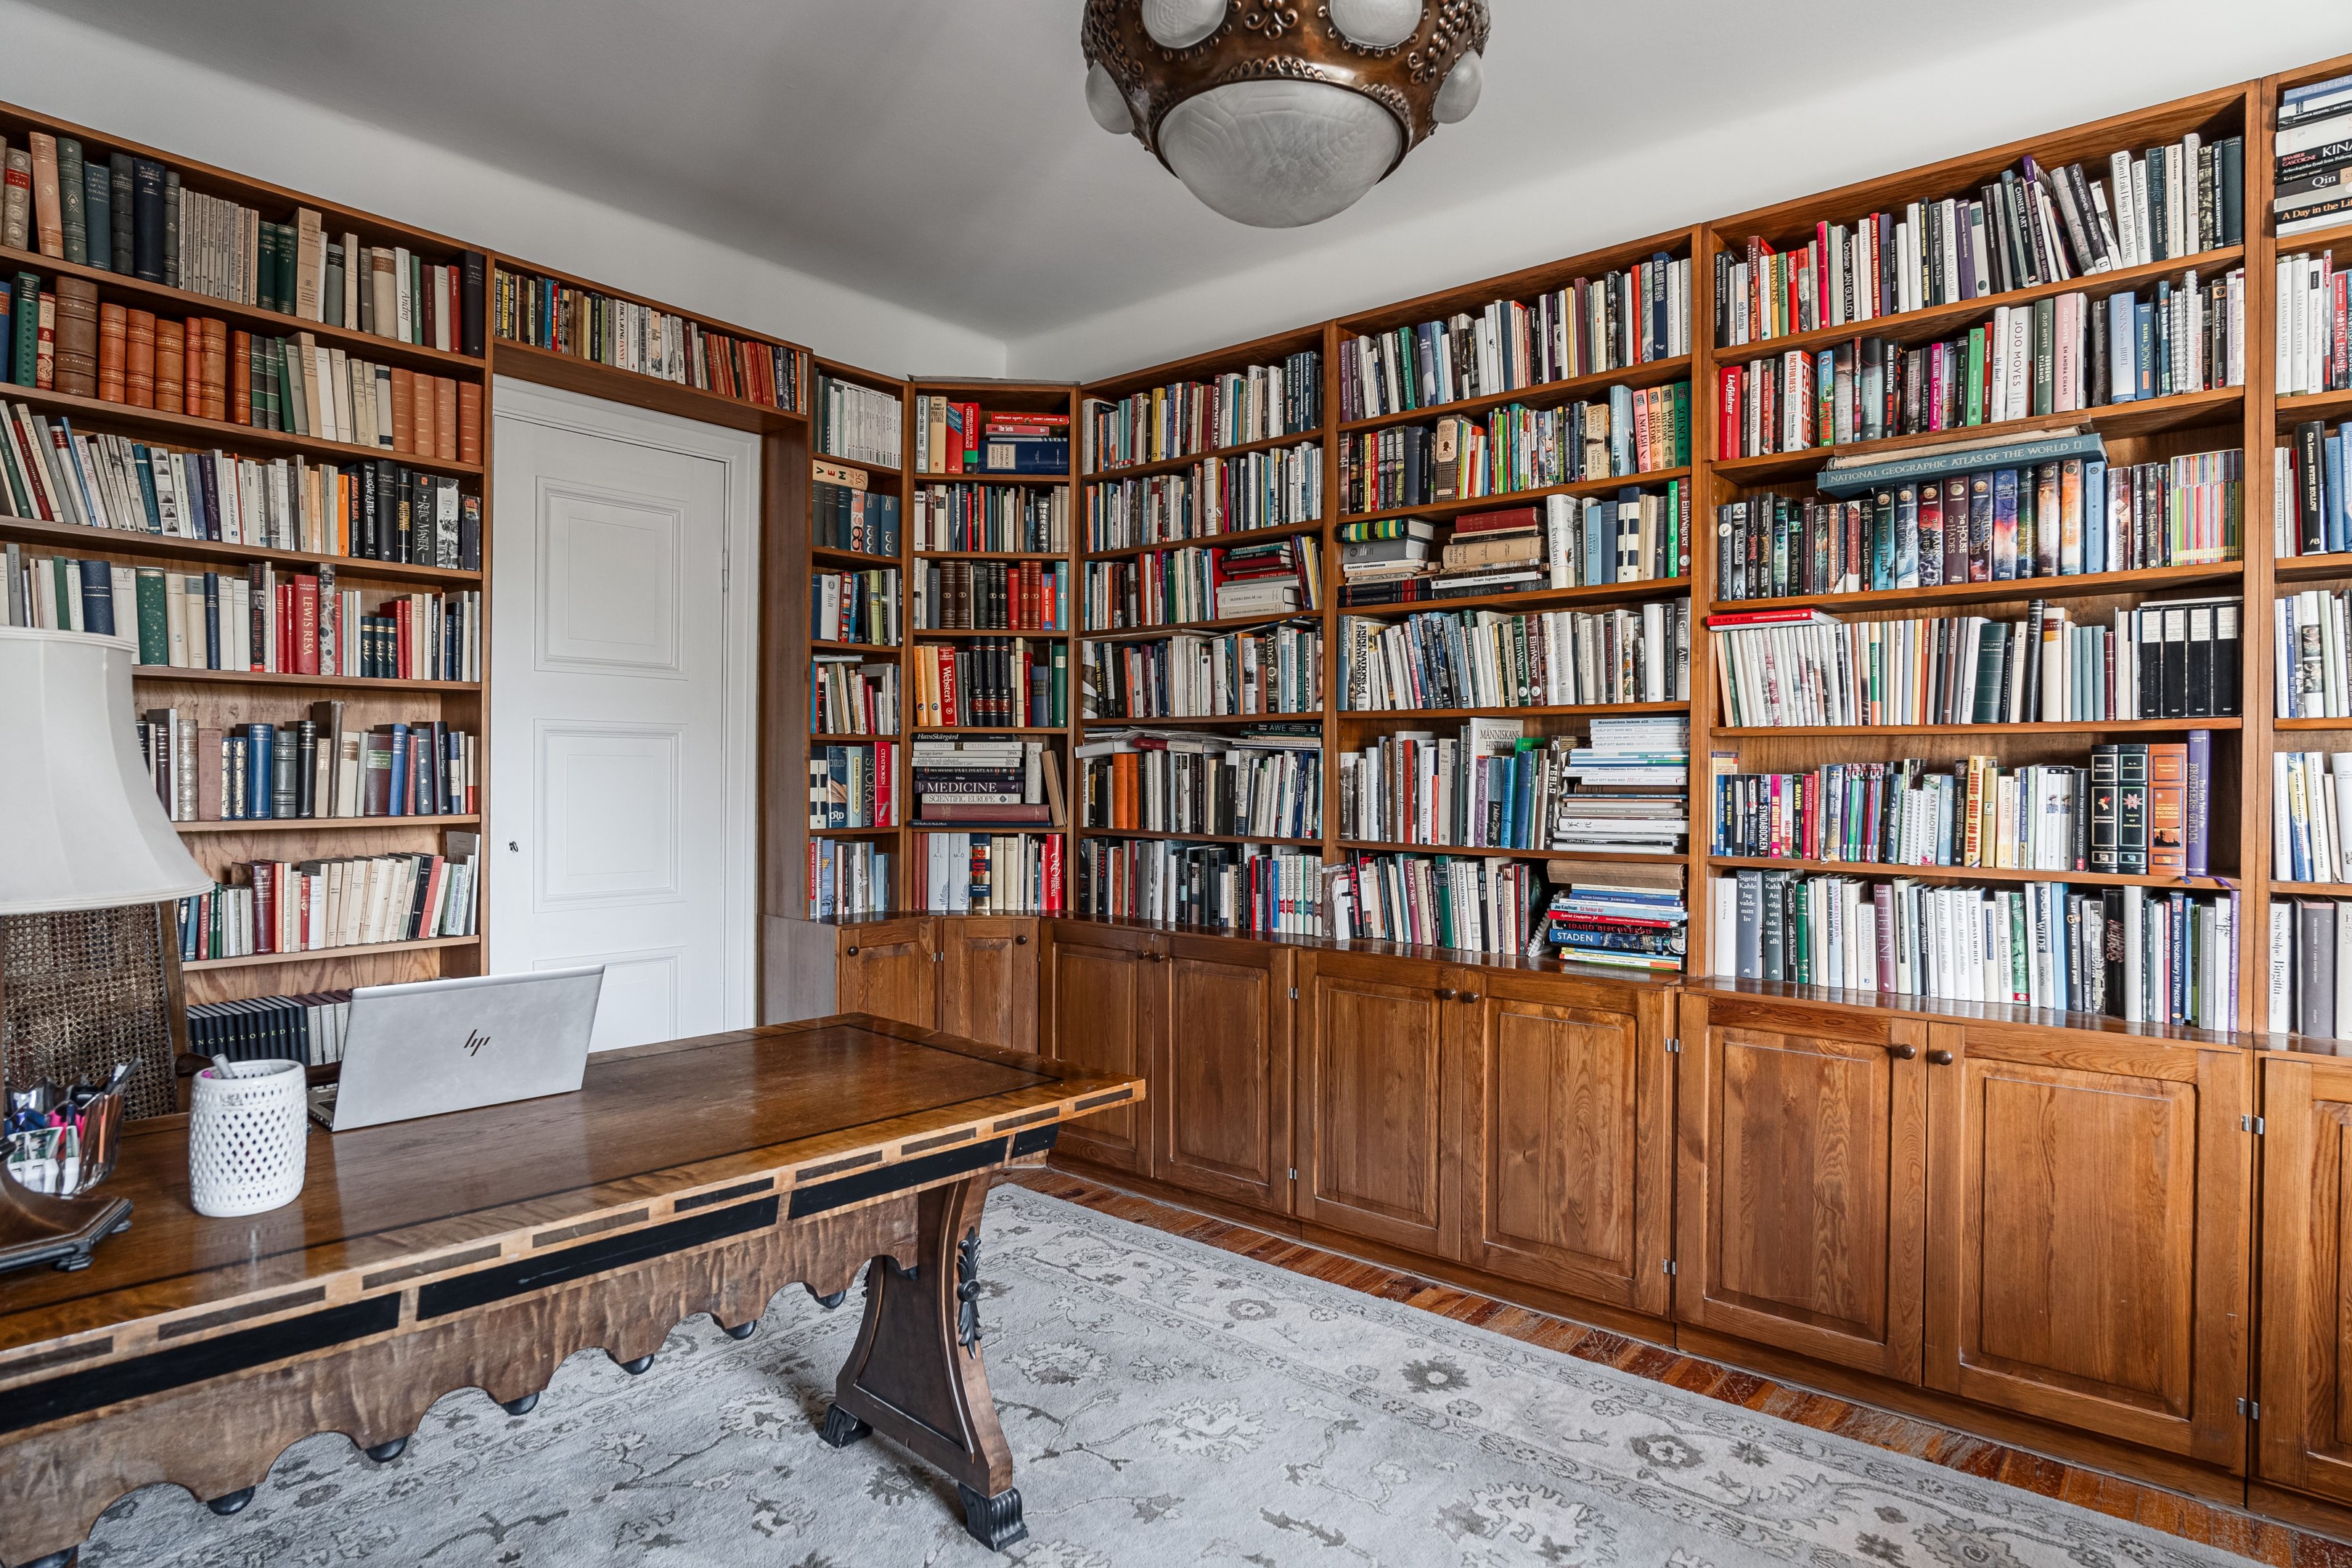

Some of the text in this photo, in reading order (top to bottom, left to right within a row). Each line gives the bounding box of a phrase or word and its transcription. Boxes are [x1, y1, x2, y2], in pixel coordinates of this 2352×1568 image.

[2282, 152, 2305, 161] BAMBER
[2282, 155, 2316, 167] GASCOIGNE
[139, 173, 161, 182] CARNEGIE
[2312, 176, 2336, 187] Qin
[2015, 187, 2024, 215] CHINESE
[2292, 207, 2309, 218] Day
[2323, 201, 2339, 212] the
[401, 290, 411, 322] Andrej
[2014, 321, 2022, 355] JOJO
[1639, 413, 1648, 447] ENGLISH
[1678, 407, 1686, 443] SCIENCE
[1831, 443, 2069, 484] NATIONAL GEOGRAPHIC ATLAS OF THE WORLD
[417, 501, 430, 552] RELIC MASTER
[303, 596, 314, 656] LEWIS RESA
[1267, 634, 1277, 683] Amos Oz
[1678, 620, 1688, 674] Gustaf Aulén
[1480, 729, 1520, 740] MÄNNISKANS
[1486, 742, 1514, 751] HISTORIA
[927, 782, 997, 793] MEDICINE
[2189, 763, 2198, 811] BROTHERS
[973, 849, 986, 877] PLUS
[1557, 932, 1593, 942] STADEN
[1598, 923, 1651, 934] DISCOVERED
[1879, 907, 1891, 963] HELENE
[2037, 920, 2046, 952] WILDE
[2272, 960, 2284, 995] Birgitta
[464, 1029, 491, 1057] hp
